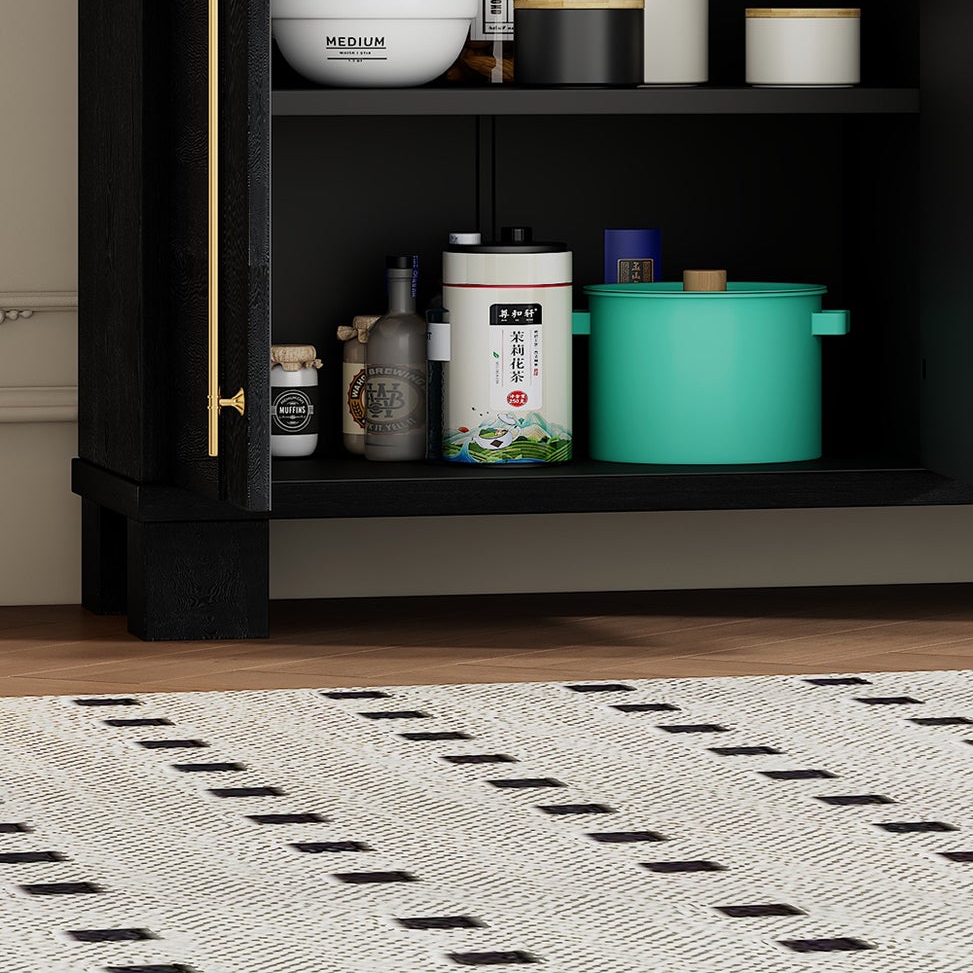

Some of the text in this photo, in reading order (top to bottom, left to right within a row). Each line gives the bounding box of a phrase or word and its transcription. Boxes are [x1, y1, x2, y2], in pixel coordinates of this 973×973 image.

[326, 36, 386, 47] MEDIUM
[510, 330, 525, 384] 茉莉花茶
[279, 406, 306, 414] MUFFINS
